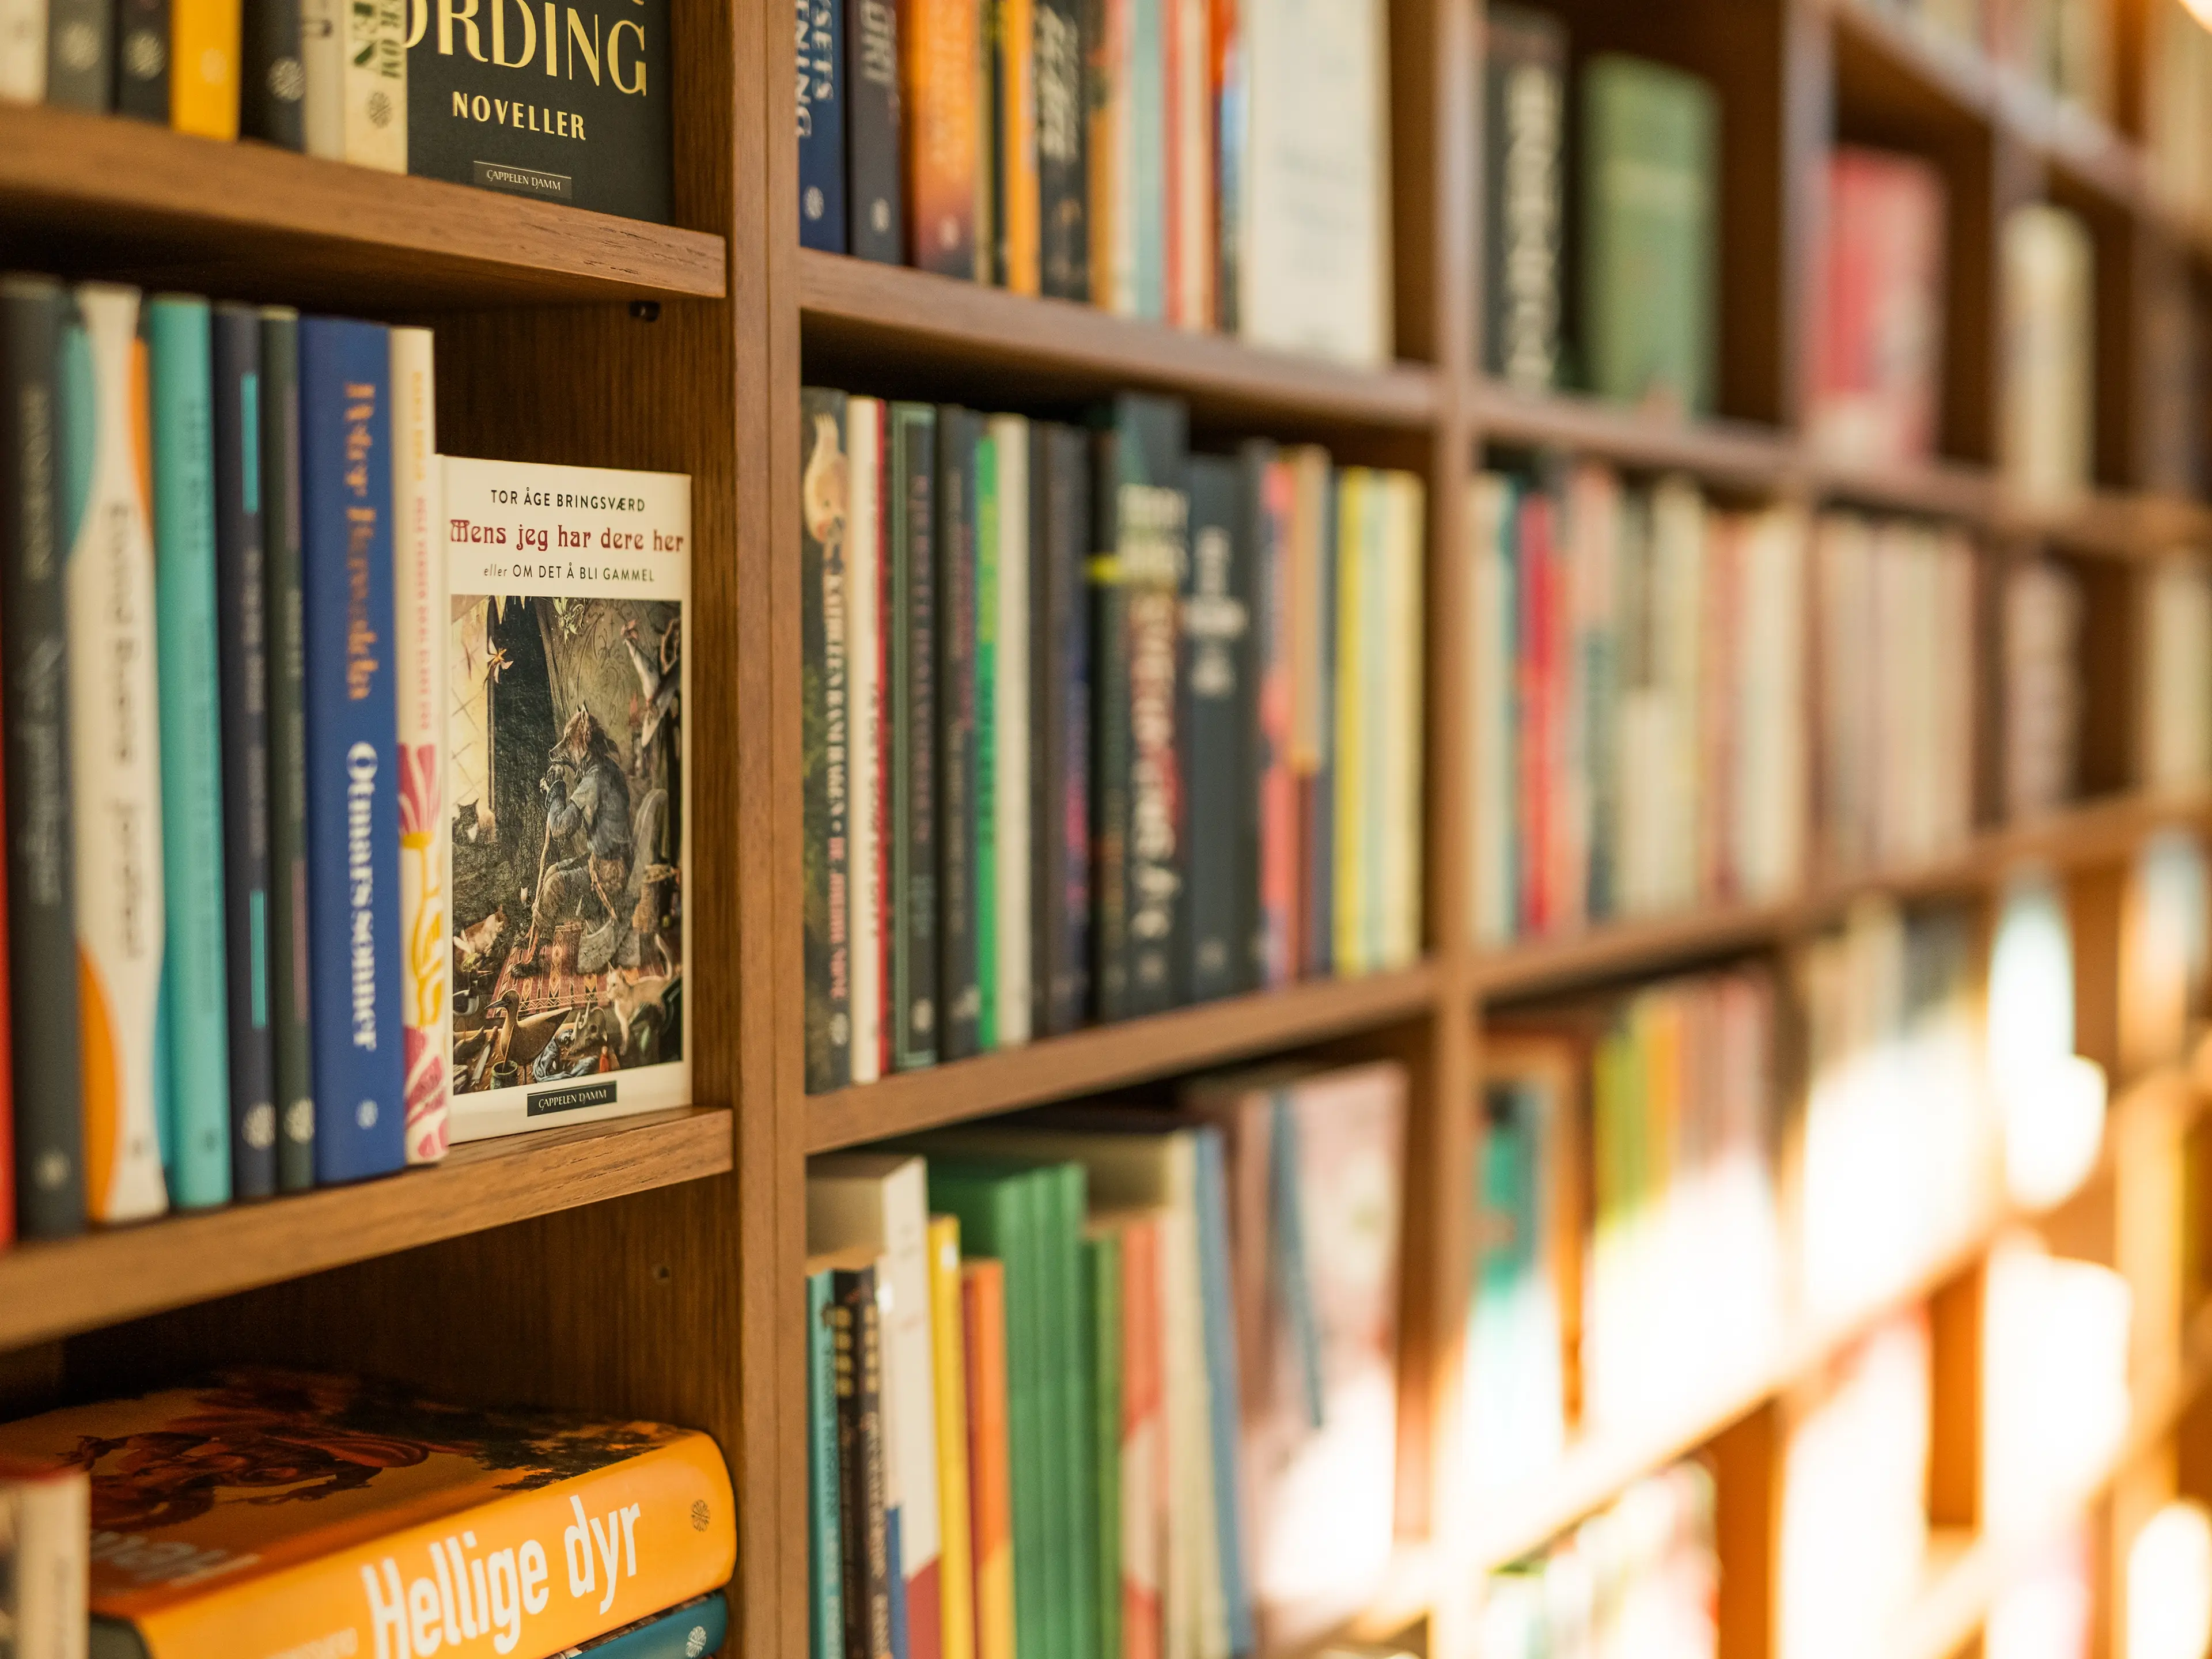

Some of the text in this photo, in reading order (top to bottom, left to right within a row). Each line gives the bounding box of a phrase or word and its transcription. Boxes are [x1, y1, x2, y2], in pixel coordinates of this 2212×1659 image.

[452, 91, 586, 141] NOVELLER
[487, 169, 561, 191] CAPPELEN DAMM
[491, 487, 646, 512] TOR ÅGE BRINGSVÆRD
[450, 519, 684, 552] Mens jeg har dere her
[484, 562, 655, 582] eller OM DET Å BLI GAMMEL
[539, 1089, 607, 1111] CAPPELEN DAMM
[361, 1531, 549, 1659] Hellige
[564, 1494, 641, 1615] dyr
